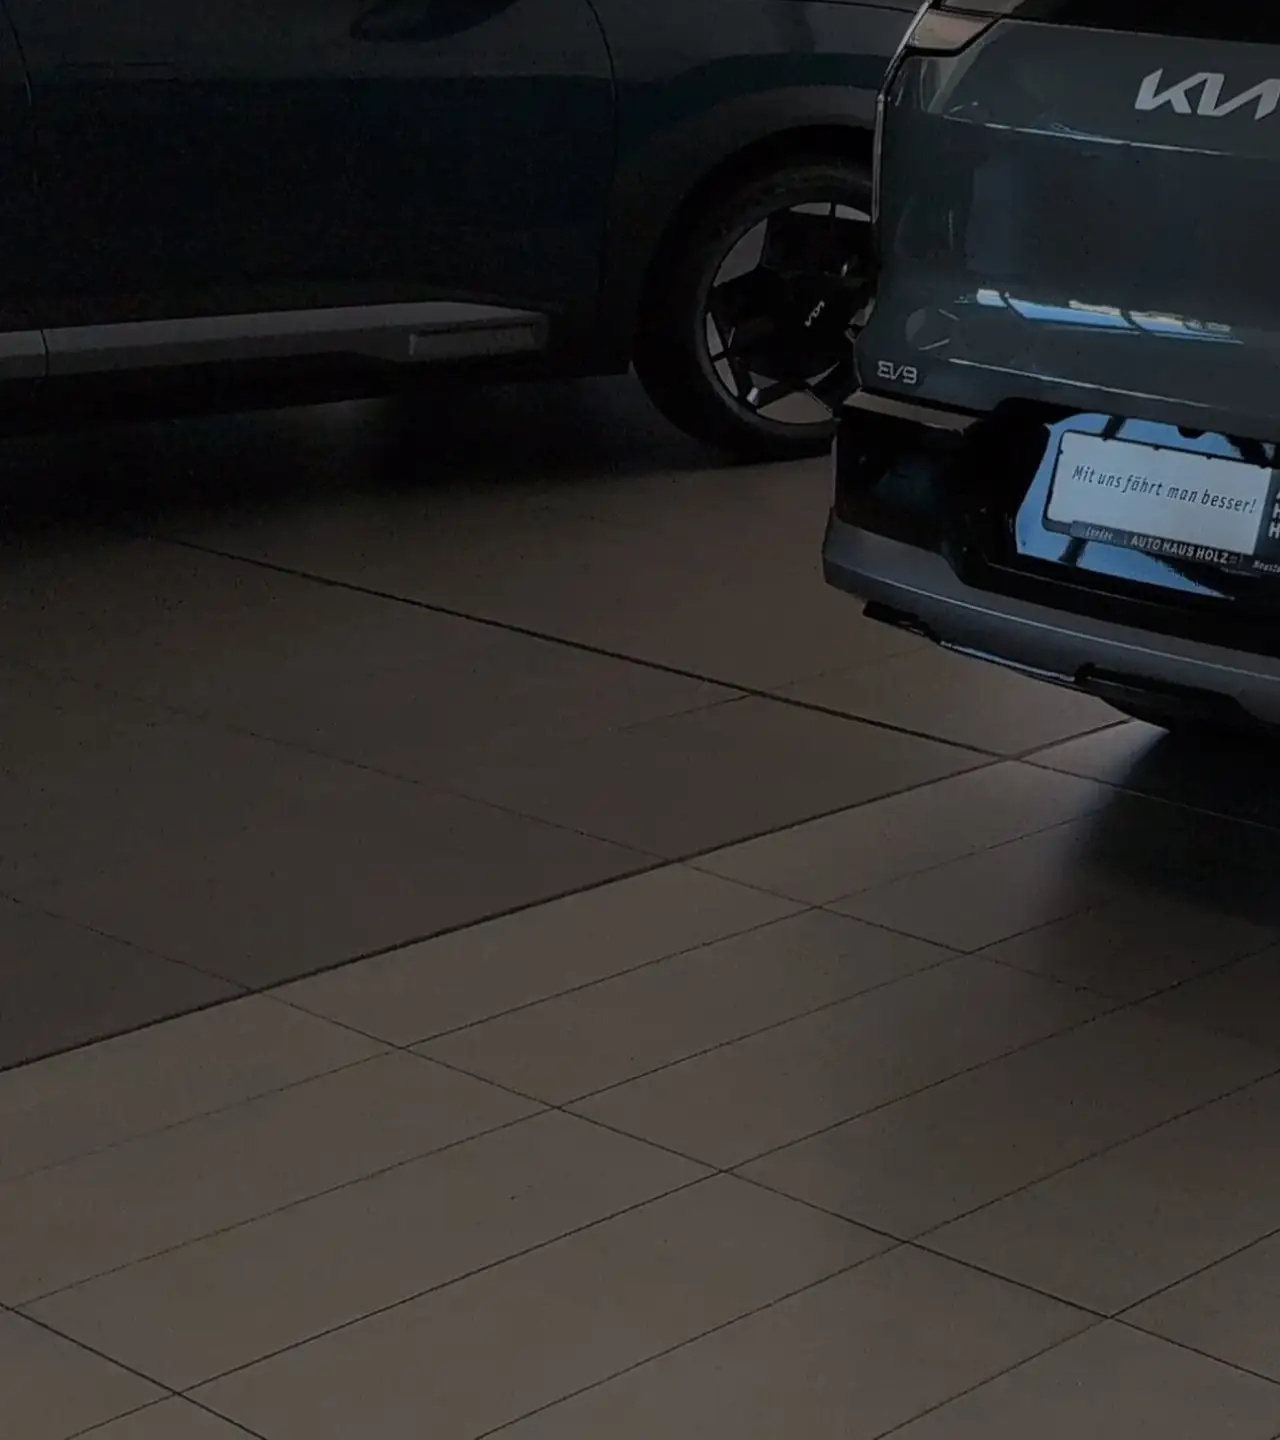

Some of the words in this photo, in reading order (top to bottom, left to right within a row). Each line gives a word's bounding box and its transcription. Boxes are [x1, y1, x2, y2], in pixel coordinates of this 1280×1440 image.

[877, 360, 918, 385] EV9
[1071, 464, 1096, 482] Mit
[1097, 472, 1122, 490] uns
[1120, 474, 1164, 496] fährt
[1166, 487, 1198, 503] man
[1200, 489, 1257, 514] besser!
[1129, 534, 1162, 551] AUTO
[1162, 539, 1195, 558] HAUS
[1196, 545, 1229, 564] HOLZ
